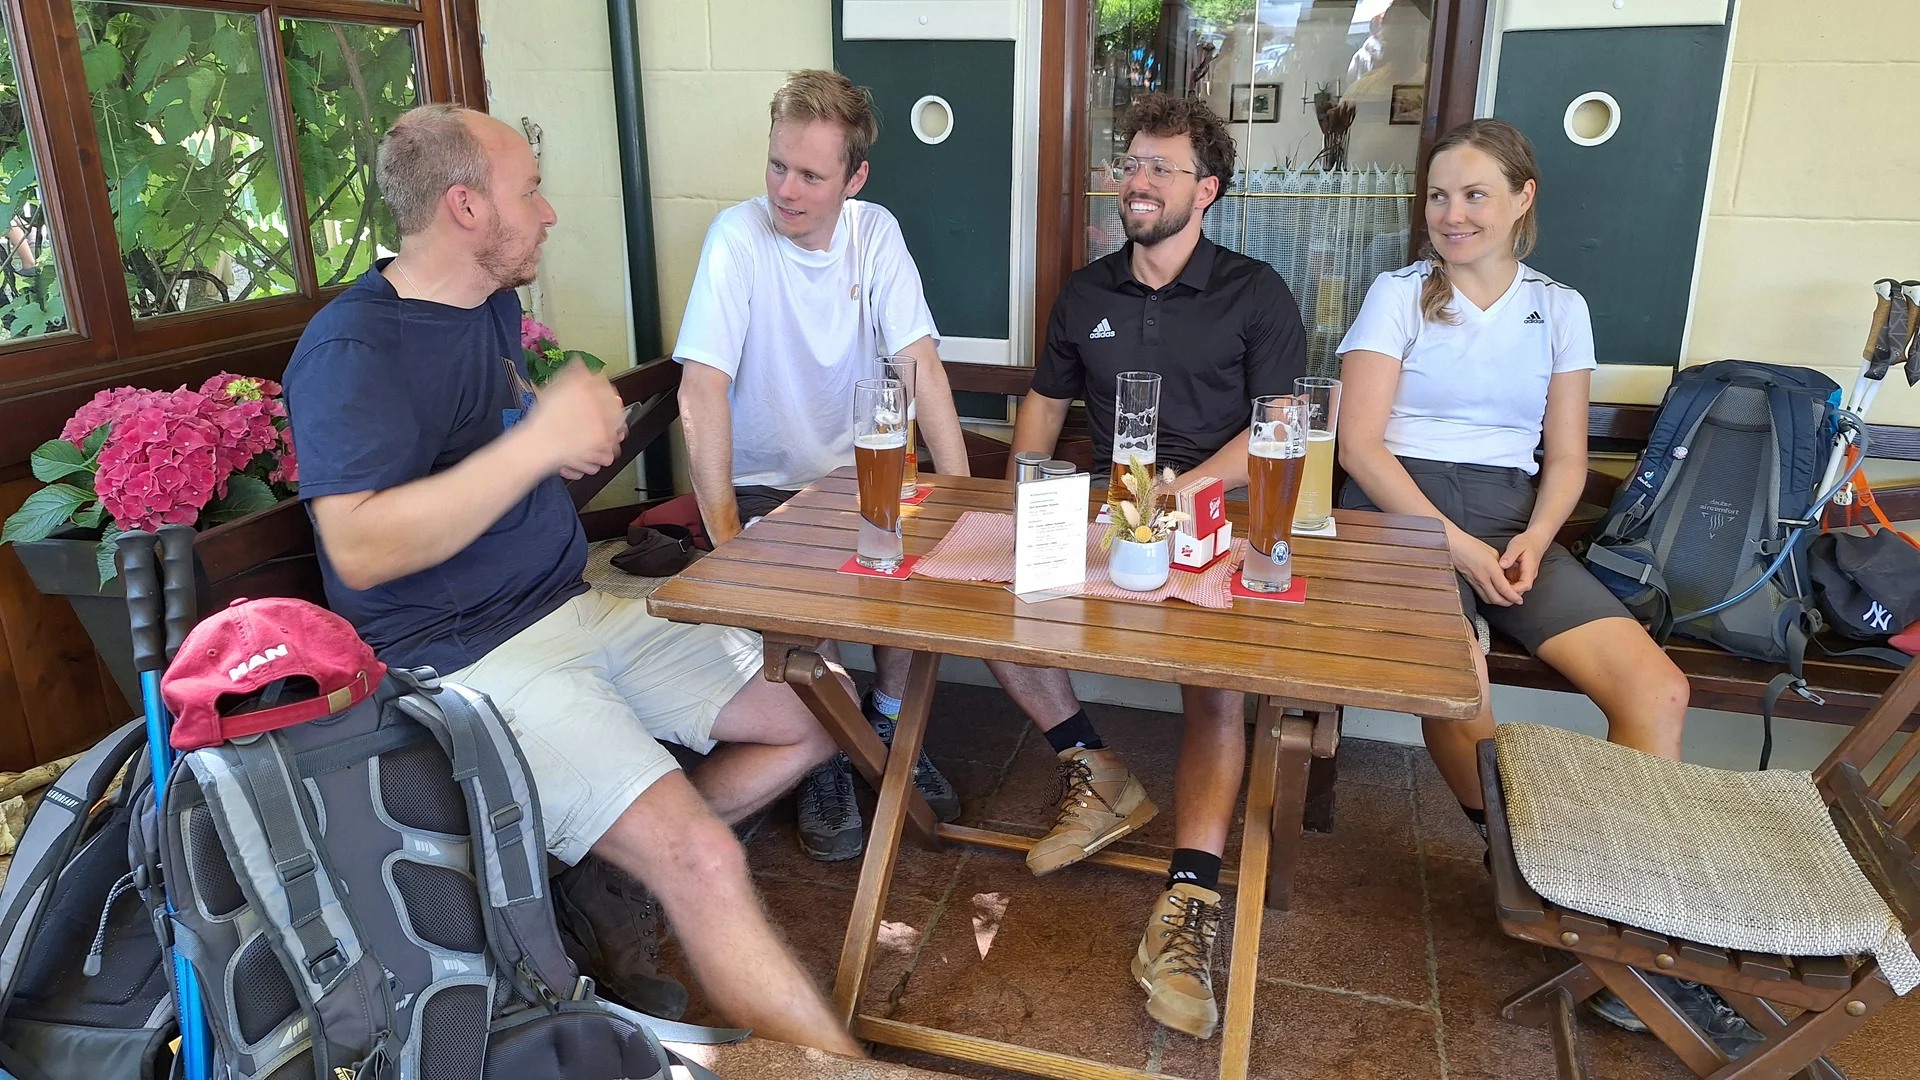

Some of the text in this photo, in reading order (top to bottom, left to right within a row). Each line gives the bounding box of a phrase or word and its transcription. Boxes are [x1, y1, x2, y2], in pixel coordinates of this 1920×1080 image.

[1090, 330, 1116, 339] adidas
[1700, 503, 1740, 516] aircomfort
[1862, 600, 1893, 631] NY
[229, 643, 289, 683] MAN
